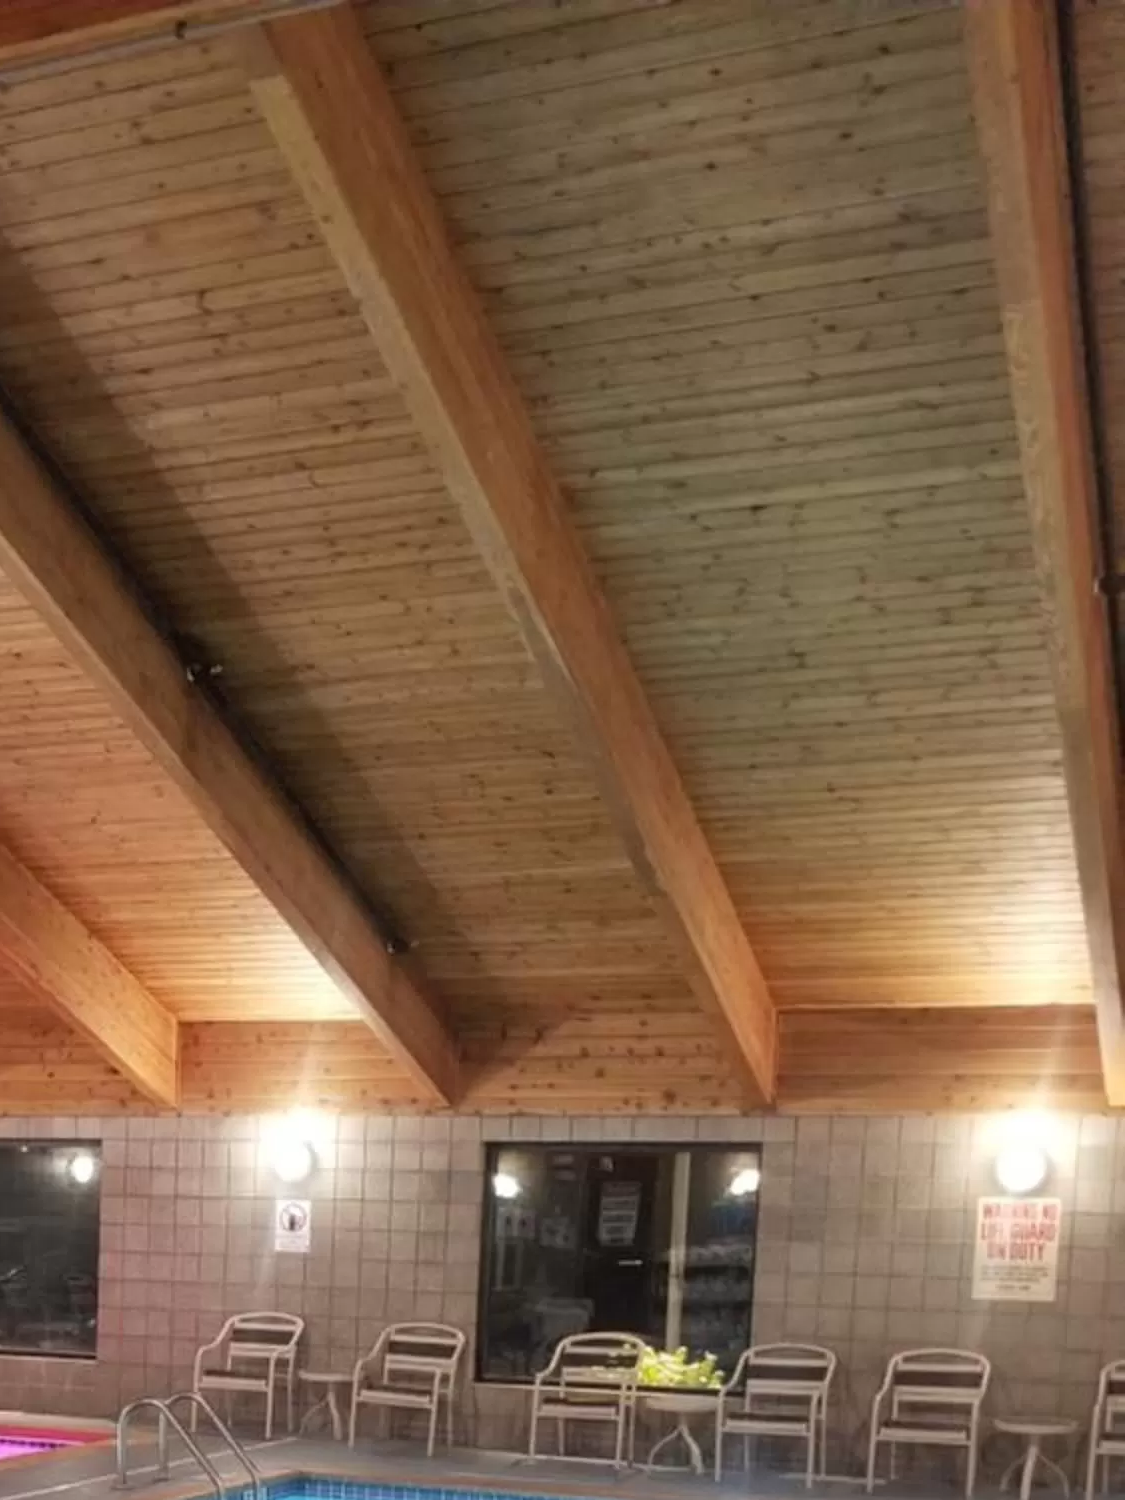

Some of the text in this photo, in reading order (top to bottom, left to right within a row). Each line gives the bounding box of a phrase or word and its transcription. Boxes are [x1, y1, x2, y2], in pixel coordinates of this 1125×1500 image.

[1041, 1203, 1058, 1221] NO
[986, 1241, 1044, 1262] ON DUTY
